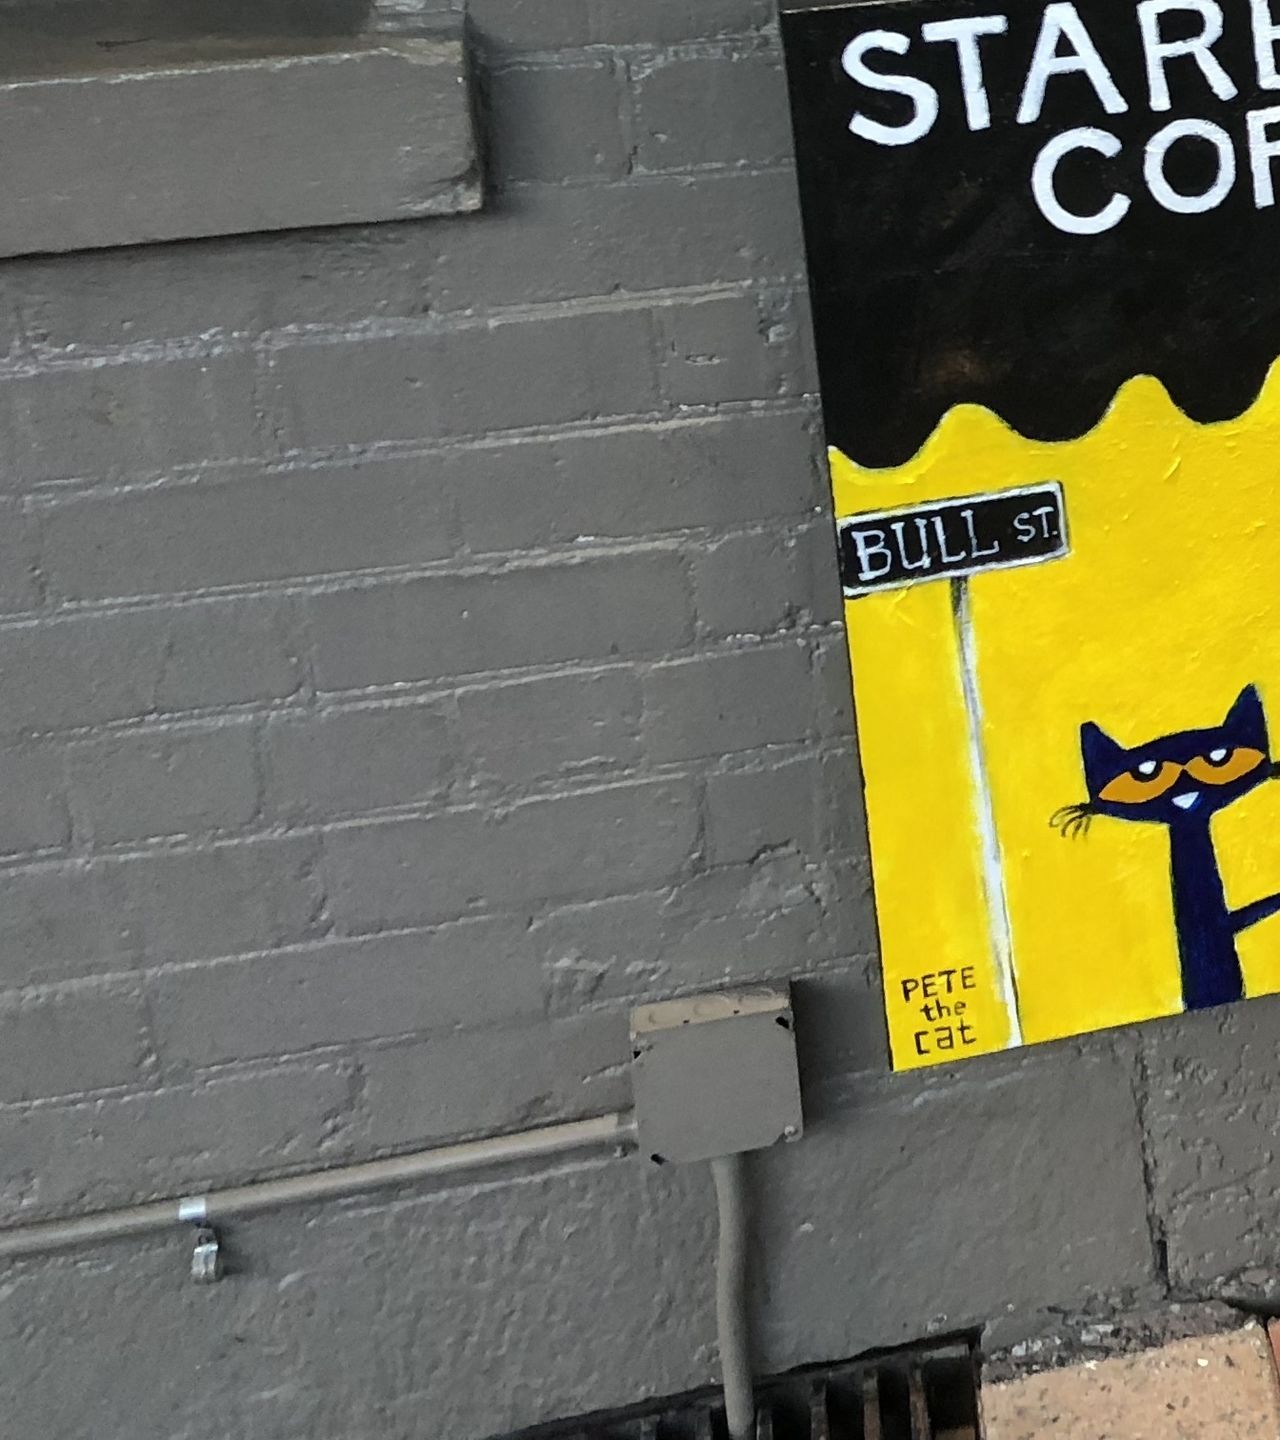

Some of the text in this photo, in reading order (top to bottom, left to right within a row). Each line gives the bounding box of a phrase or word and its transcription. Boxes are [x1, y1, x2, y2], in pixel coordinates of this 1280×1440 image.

[851, 509, 1000, 581] BULL
[901, 966, 977, 1002] PETE
[920, 999, 967, 1022] the
